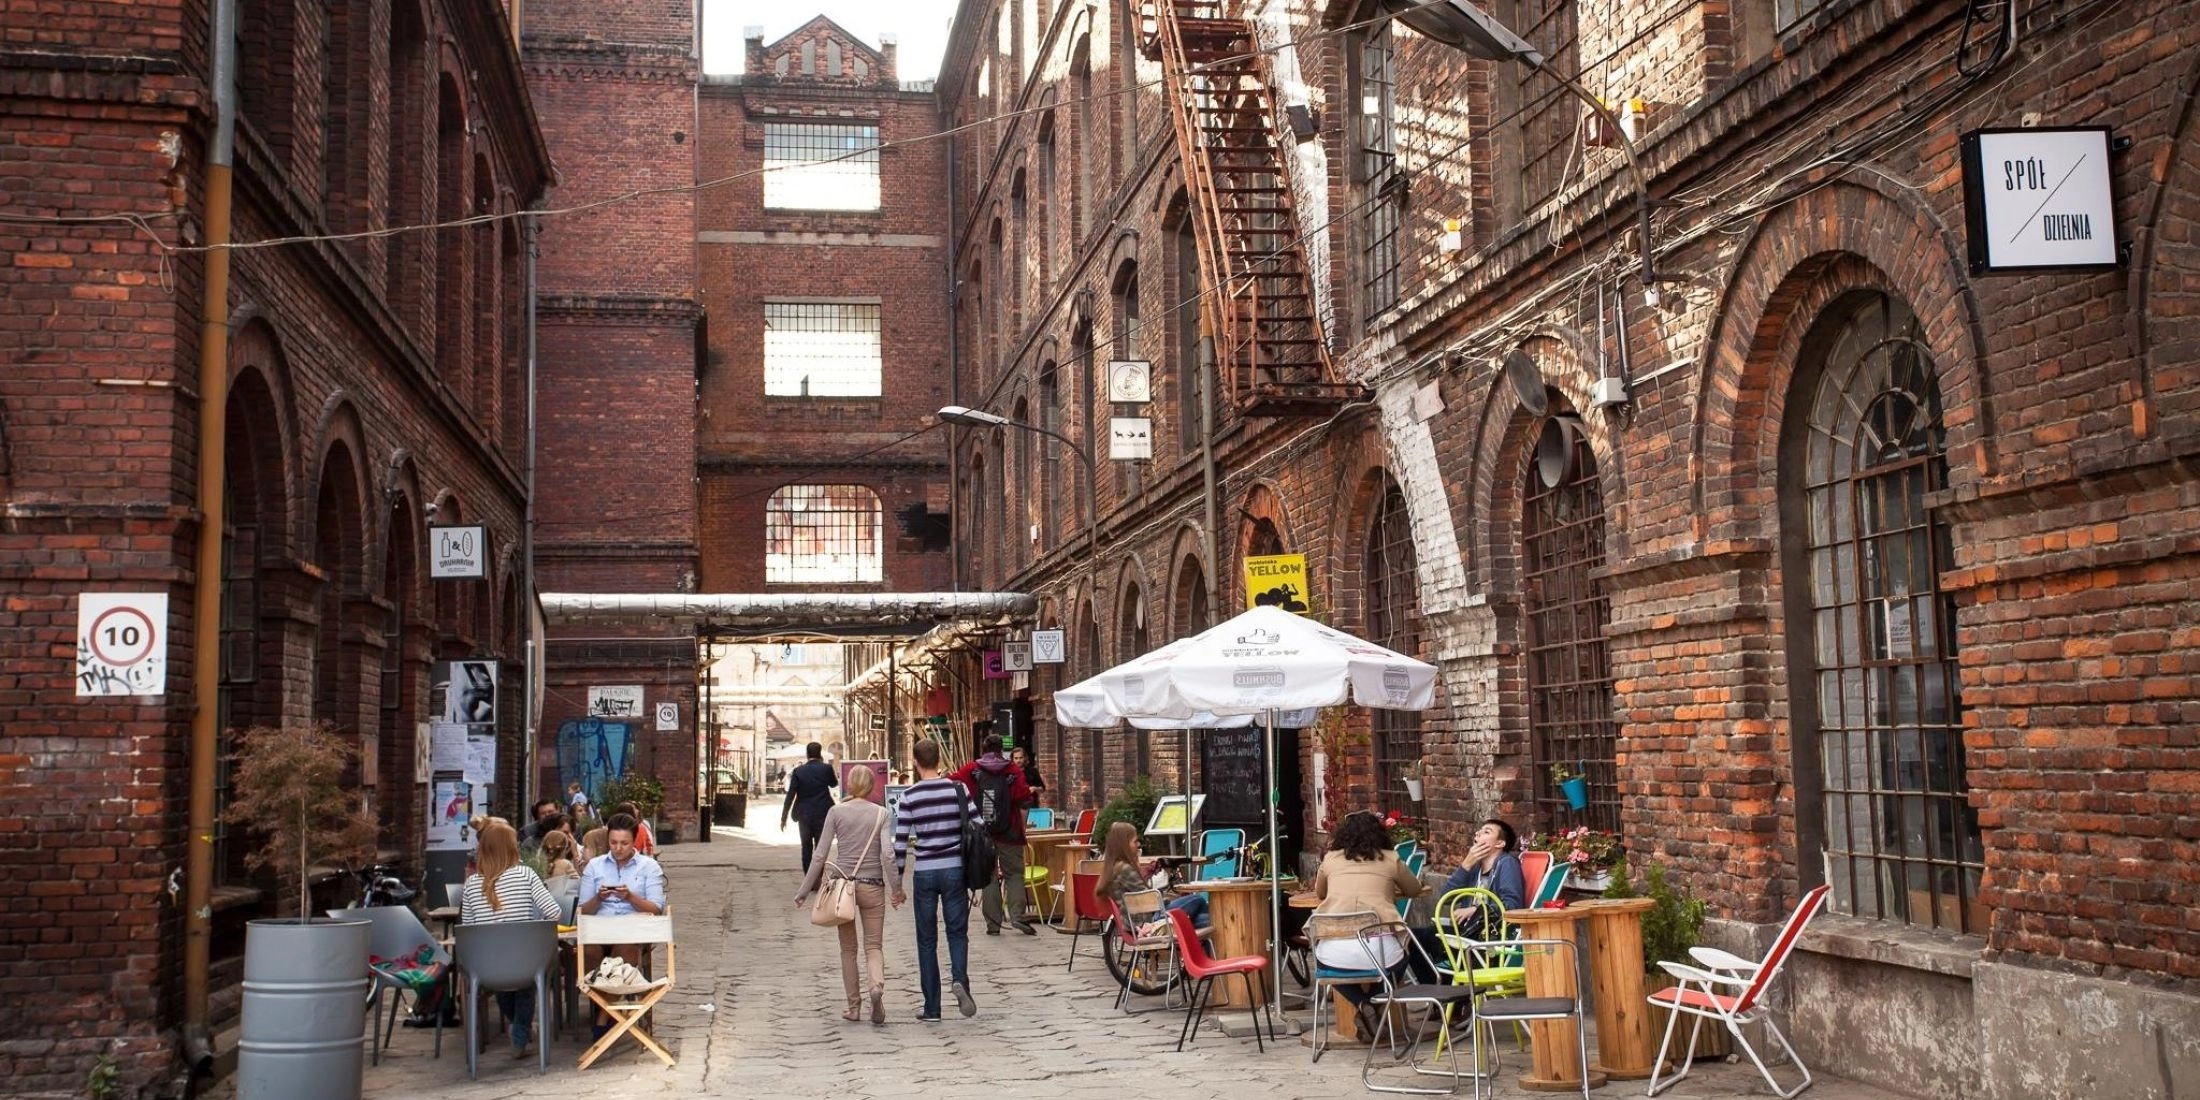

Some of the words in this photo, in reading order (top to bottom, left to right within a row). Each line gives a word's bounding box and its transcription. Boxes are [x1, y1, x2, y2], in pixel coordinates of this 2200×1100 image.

[2004, 156, 2047, 191] SPÓŁ
[2043, 214, 2092, 241] DZIELNIA
[1249, 563, 1301, 576] YELLOW
[105, 627, 139, 646] 10
